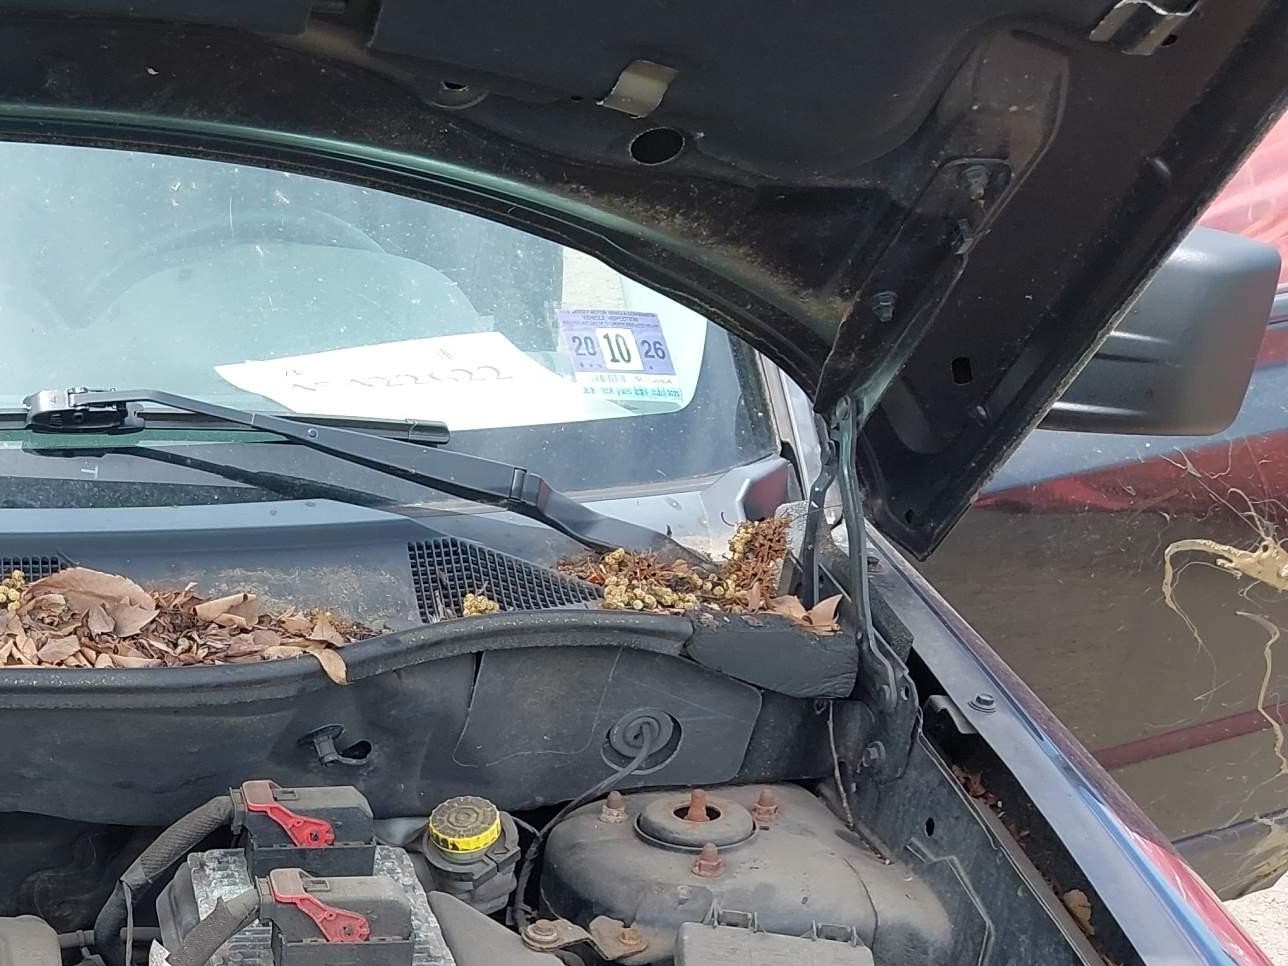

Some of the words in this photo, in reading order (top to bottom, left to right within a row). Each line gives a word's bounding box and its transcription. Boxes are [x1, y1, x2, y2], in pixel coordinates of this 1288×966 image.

[572, 335, 597, 357] 20
[603, 332, 632, 363] 10
[641, 339, 666, 360] 26
